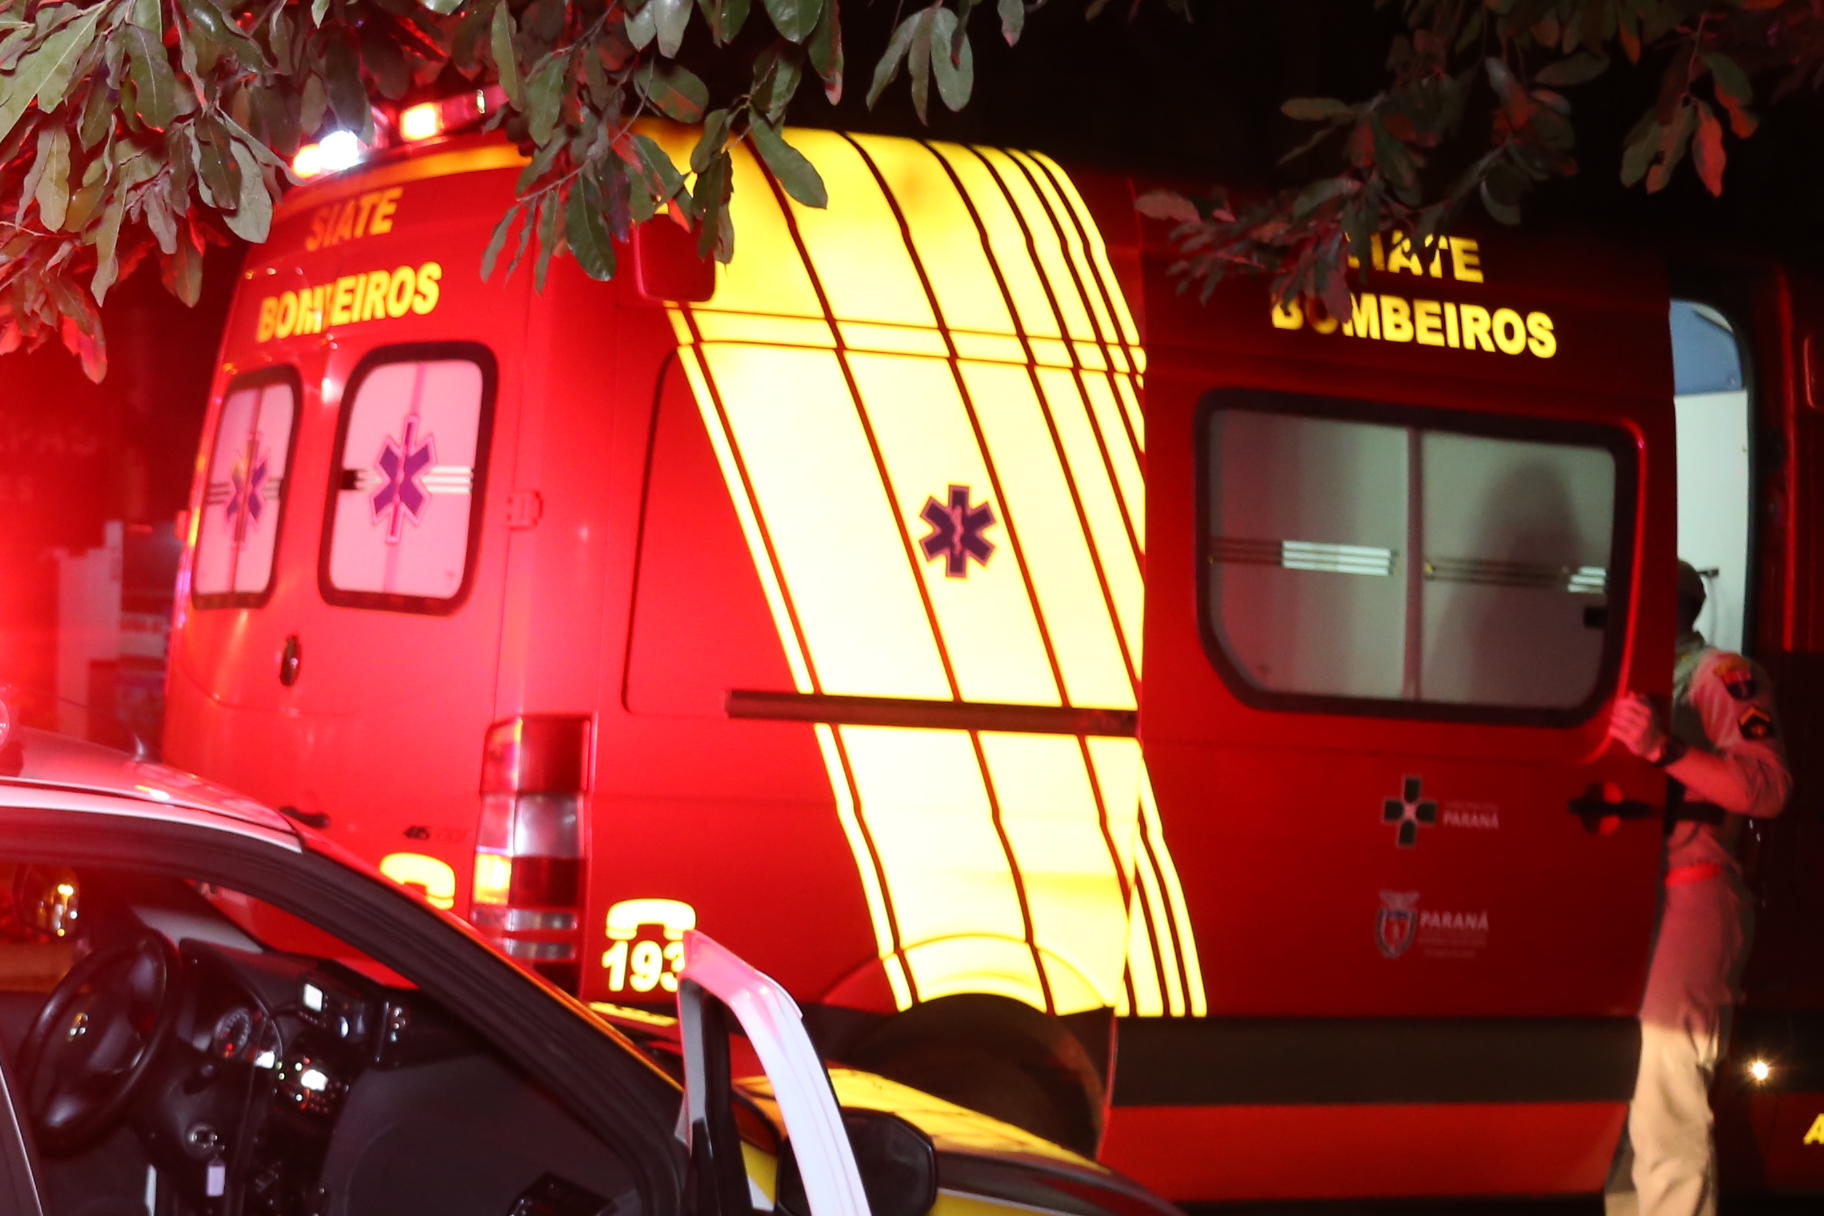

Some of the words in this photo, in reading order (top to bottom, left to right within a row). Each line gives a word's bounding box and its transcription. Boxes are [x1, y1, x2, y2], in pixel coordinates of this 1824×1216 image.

[306, 187, 403, 251] SIATE
[1347, 229, 1484, 283] IATE
[602, 940, 686, 993] 193
